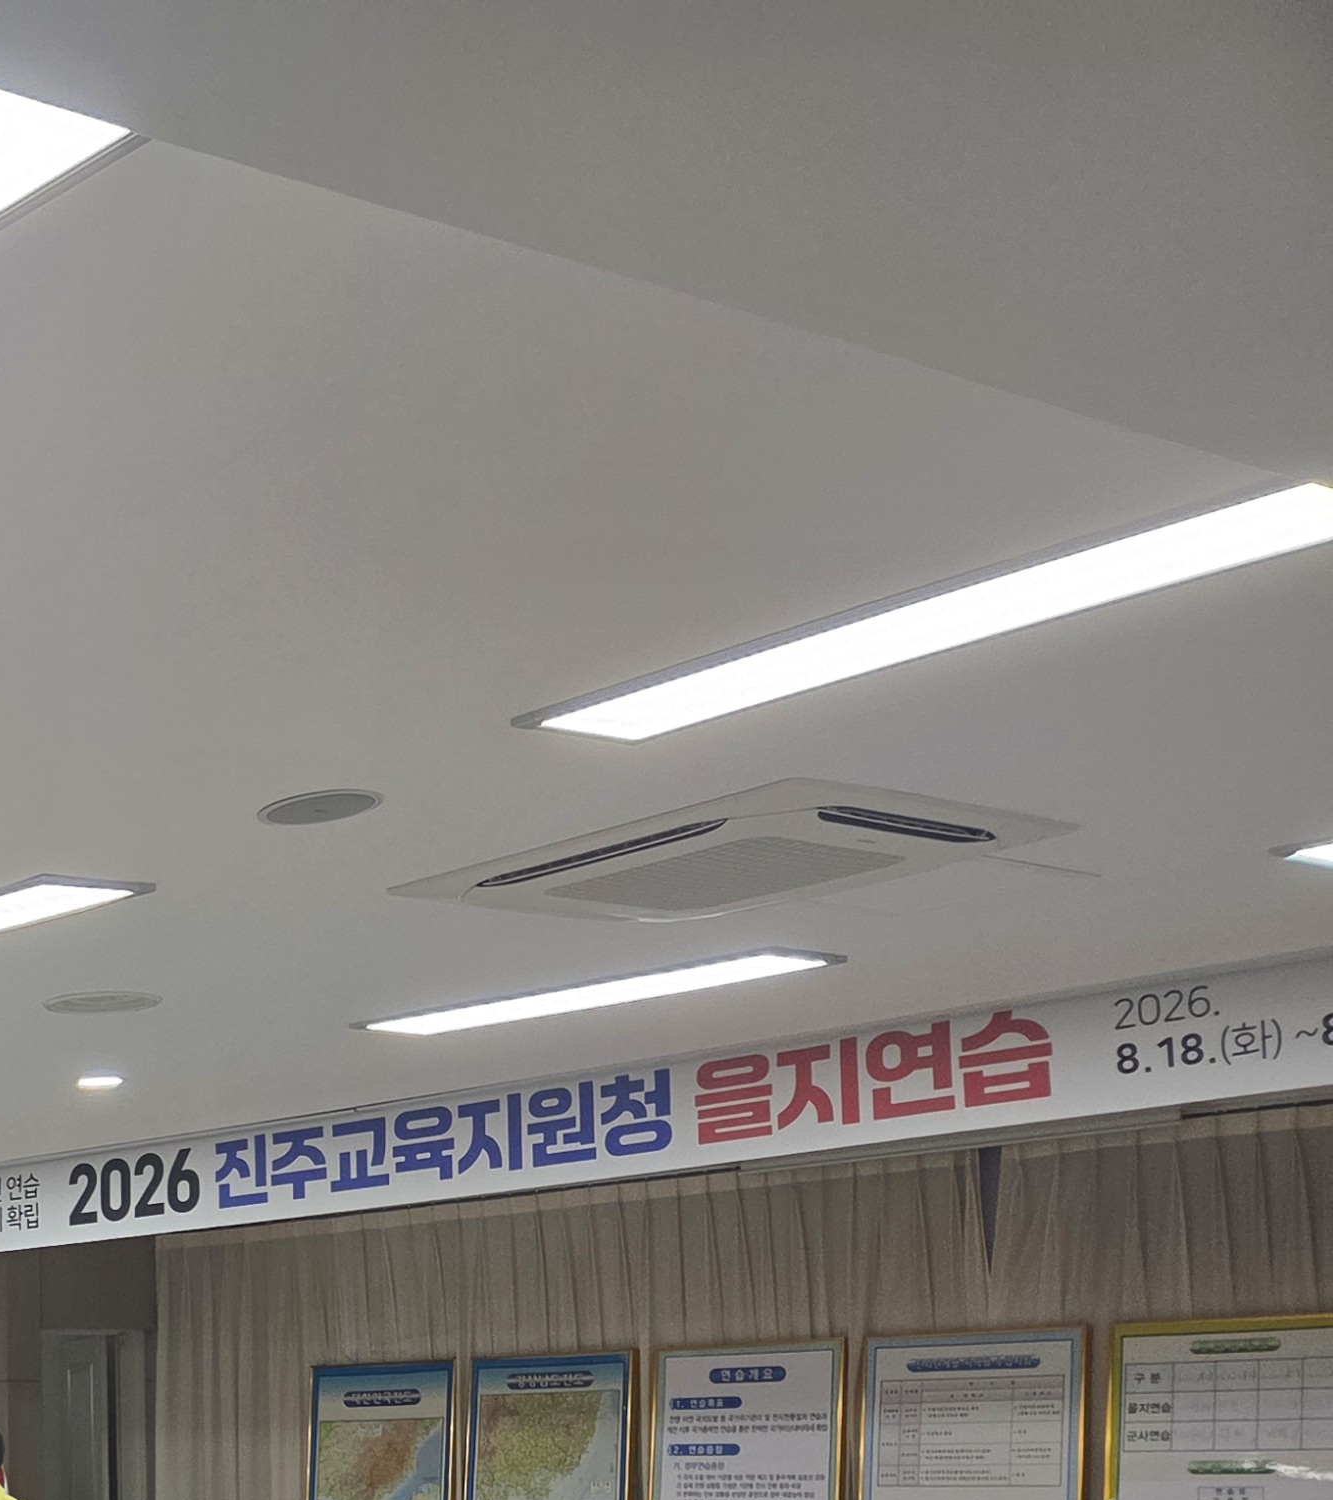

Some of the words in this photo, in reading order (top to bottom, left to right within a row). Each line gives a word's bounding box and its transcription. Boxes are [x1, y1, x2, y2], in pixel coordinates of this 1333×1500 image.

[1114, 986, 1220, 1030] 2026.
[1117, 1018, 1282, 1075] 8.18.(화)
[69, 1148, 200, 1226] 2026
[215, 1068, 673, 1209] 진주교육지원청
[694, 1010, 1053, 1145] 을지연습
[6, 1173, 40, 1201] 연습
[6, 1203, 40, 1231] 확립
[1126, 1429, 1171, 1442] 군사연습
